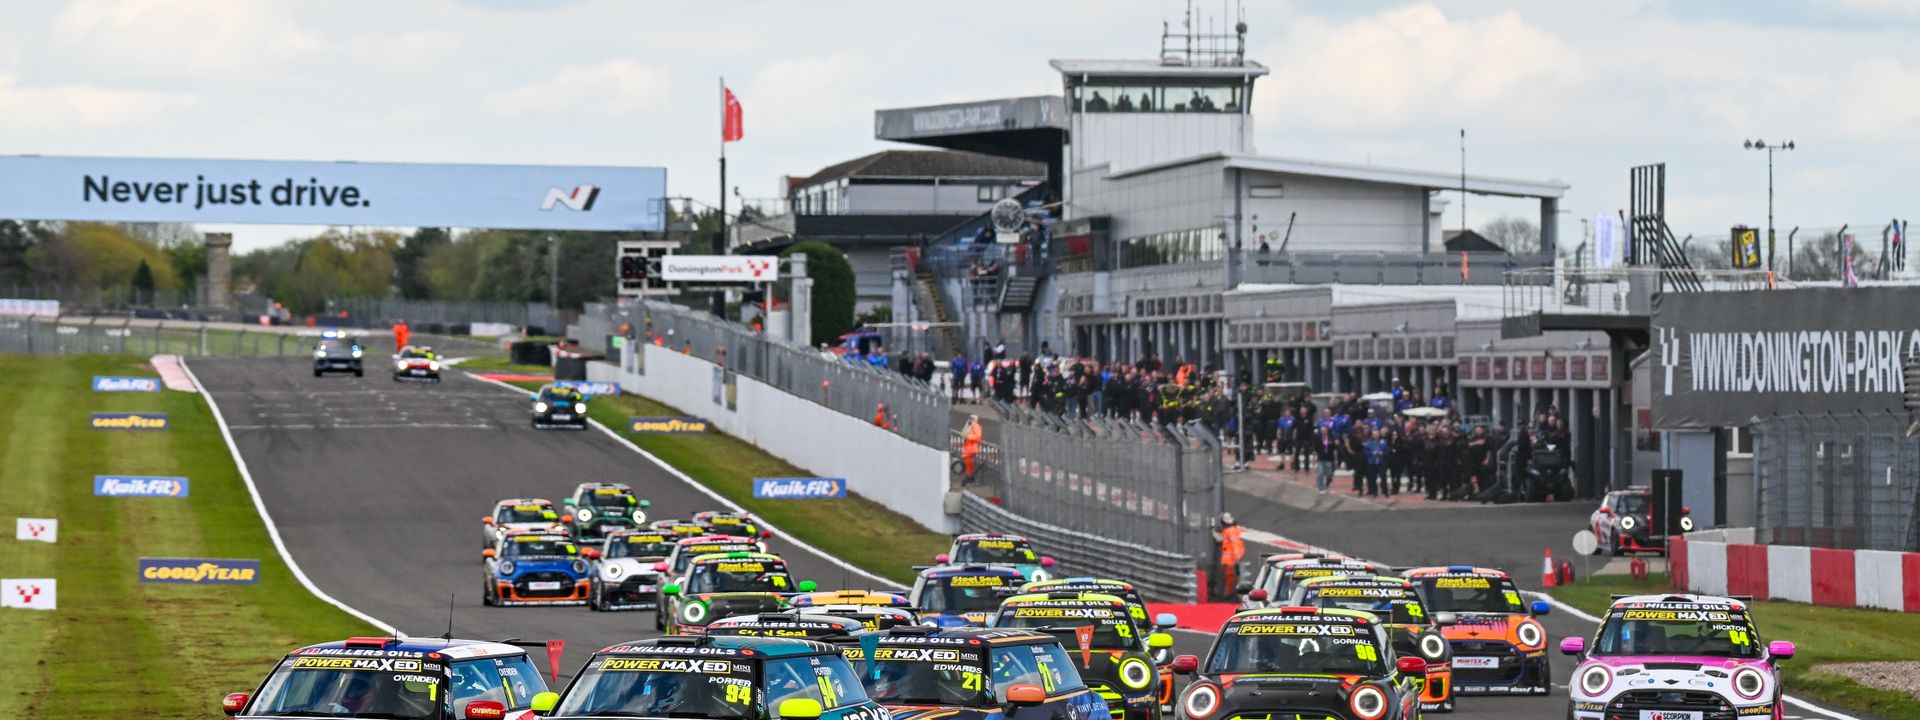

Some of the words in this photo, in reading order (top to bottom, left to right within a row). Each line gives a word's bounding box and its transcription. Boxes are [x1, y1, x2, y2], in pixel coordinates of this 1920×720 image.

[83, 174, 189, 204] Never
[194, 175, 262, 210] just
[270, 178, 370, 208] drive.
[92, 415, 166, 428] GOODYEAR
[633, 419, 705, 432] GOODYEAR
[143, 562, 255, 582] GOODYEAR
[1321, 588, 1362, 596] POWER
[1015, 609, 1063, 617] POWER
[1064, 608, 1111, 619] MAXED
[1261, 614, 1321, 622] MILLERS
[1323, 615, 1354, 623] OILS
[1627, 611, 1677, 619] POWER
[1678, 610, 1729, 622] MAXED
[799, 621, 830, 629] OILS
[1243, 625, 1295, 633] POWER
[1296, 624, 1352, 635] MAXED
[1713, 624, 1747, 632] HICKTON
[776, 629, 808, 637] Seal
[1114, 624, 1132, 638] 12
[1332, 638, 1373, 646] GORNALL
[318, 648, 385, 657] MILLERS
[387, 650, 424, 658] OILS
[629, 645, 696, 654] MILLERS
[699, 647, 737, 656] OILS
[894, 648, 957, 661] MAXED
[295, 657, 352, 668] POWER
[353, 658, 420, 671] MAXED
[602, 659, 661, 670] POWER
[661, 659, 730, 673] MAXED
[933, 663, 982, 674] EDWARDS
[393, 674, 440, 685] OVENDEN
[708, 676, 752, 688] PORTER
[961, 671, 982, 692] 21
[428, 683, 437, 702] 1
[725, 684, 752, 706] 94
[471, 707, 501, 715] OVENDEN
[1739, 706, 1773, 714] GOODYEAR
[1662, 712, 1691, 720] SCORPION
